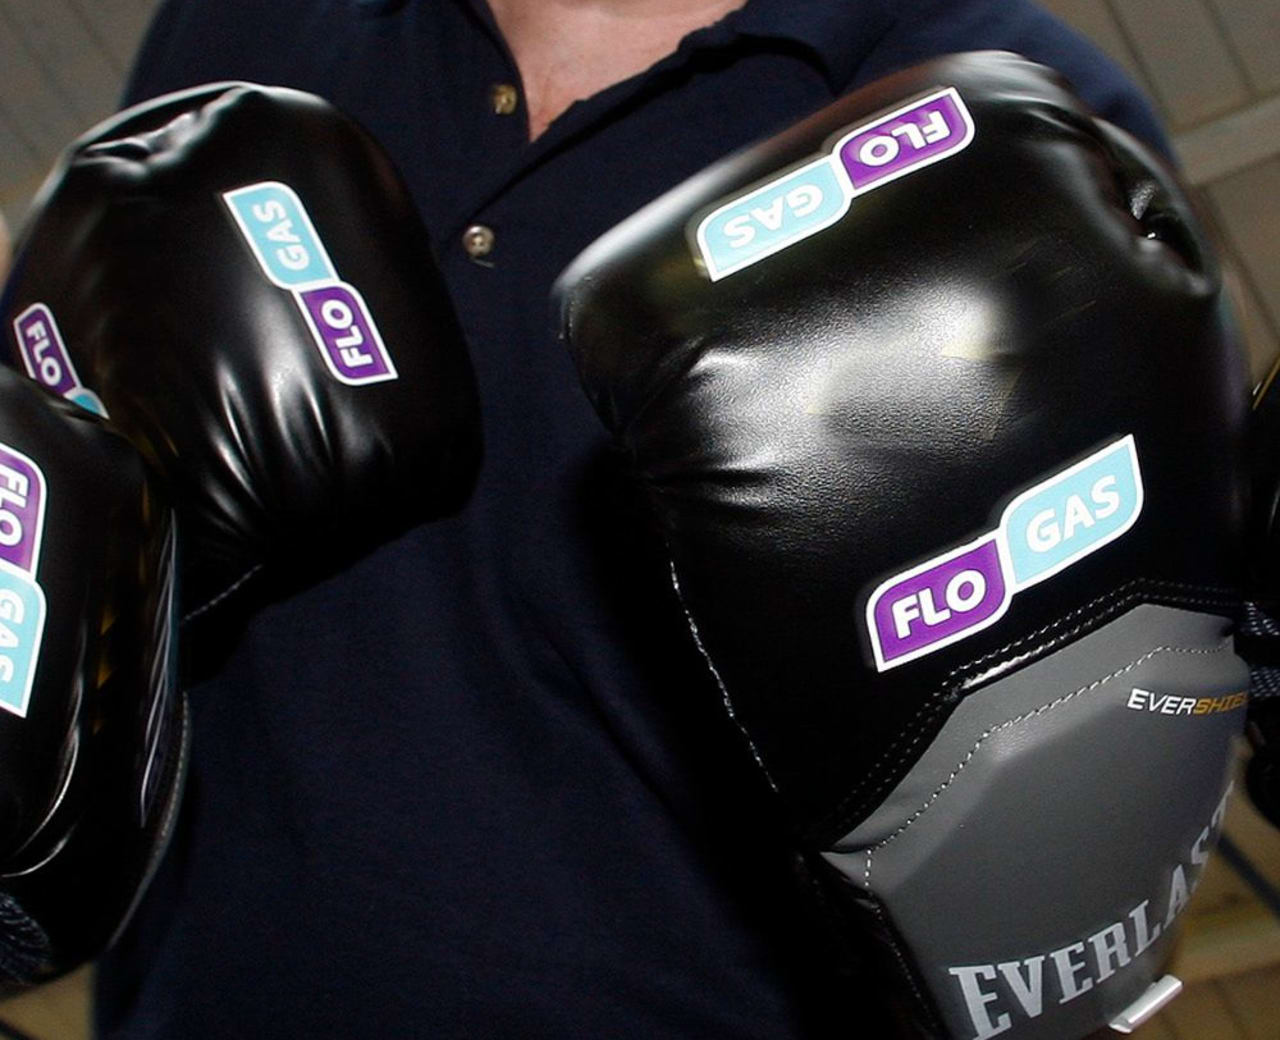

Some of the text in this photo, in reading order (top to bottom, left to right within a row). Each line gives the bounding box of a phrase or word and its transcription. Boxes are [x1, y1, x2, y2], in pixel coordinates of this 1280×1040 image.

[723, 109, 951, 250] FLO GAS
[25, 320, 62, 386] FLO
[254, 200, 373, 367] FLO GAS
[891, 476, 1120, 640] FLO GAS
